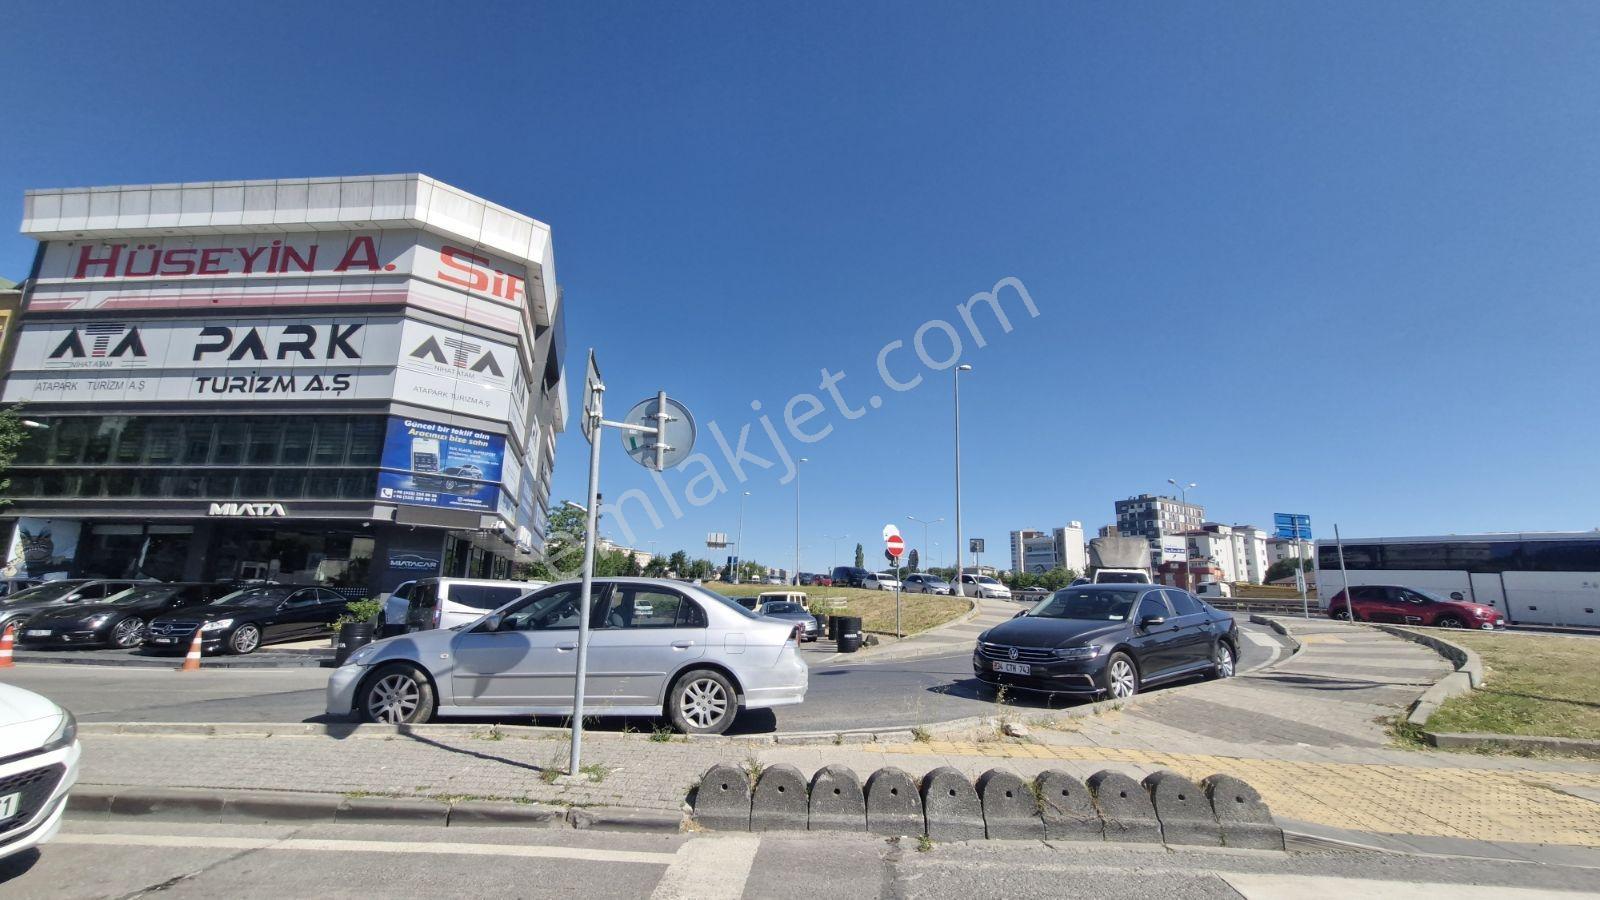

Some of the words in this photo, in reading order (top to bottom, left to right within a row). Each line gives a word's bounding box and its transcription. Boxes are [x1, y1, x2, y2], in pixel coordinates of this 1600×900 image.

[73, 240, 319, 279] HÜSEYİN
[334, 236, 396, 272] A.
[48, 323, 147, 358] ATA
[192, 323, 365, 361] PARK
[409, 334, 505, 377] ATA
[34, 381, 78, 391] ATAPARK
[195, 370, 296, 393] TURİZM
[303, 373, 352, 397] A.Ş
[412, 385, 449, 398] ATAPARK
[404, 419, 435, 431] Güncel
[437, 426, 449, 434] bir
[451, 427, 473, 437] teklif
[474, 432, 490, 440] alın
[408, 428, 447, 440] Aracınızı
[449, 435, 467, 444] bize
[209, 502, 286, 516] MIATA
[390, 560, 437, 568] MIATACAR
